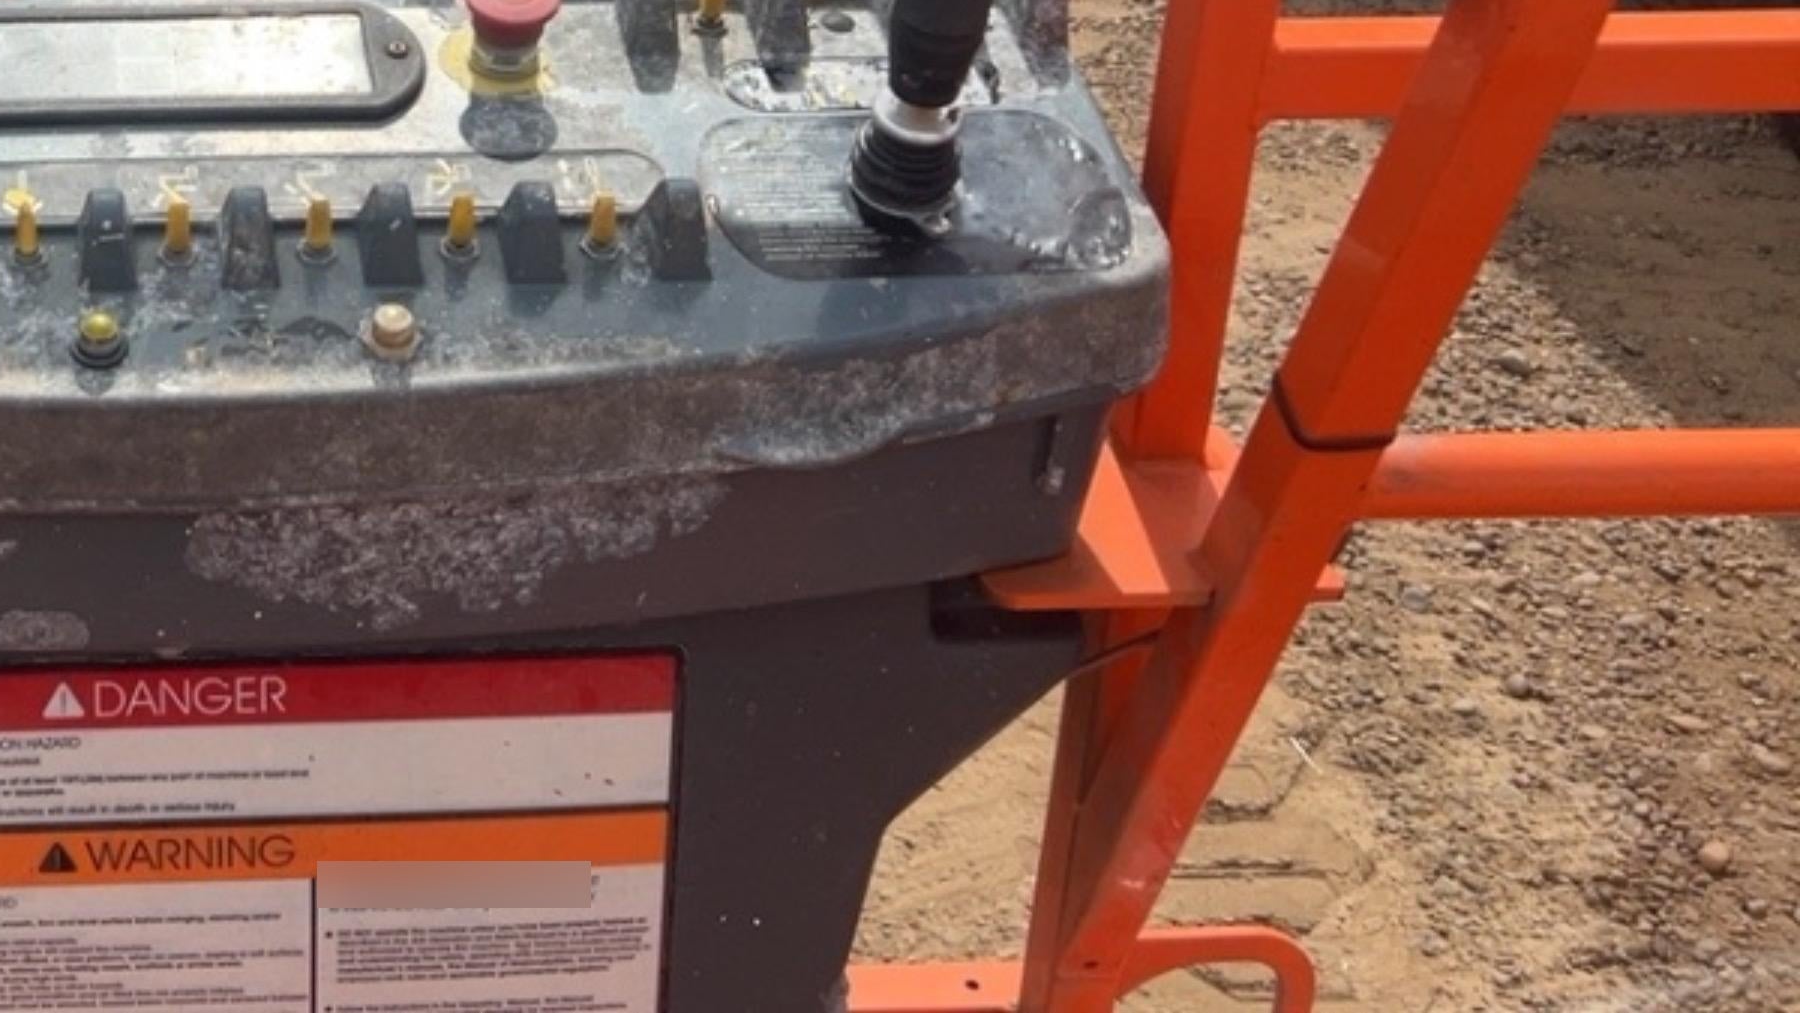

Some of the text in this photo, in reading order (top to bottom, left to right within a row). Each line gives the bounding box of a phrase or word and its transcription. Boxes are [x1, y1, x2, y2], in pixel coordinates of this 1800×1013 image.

[94, 676, 287, 718] DANGER
[25, 737, 81, 751] HAZARD
[85, 834, 295, 872] WARNING
